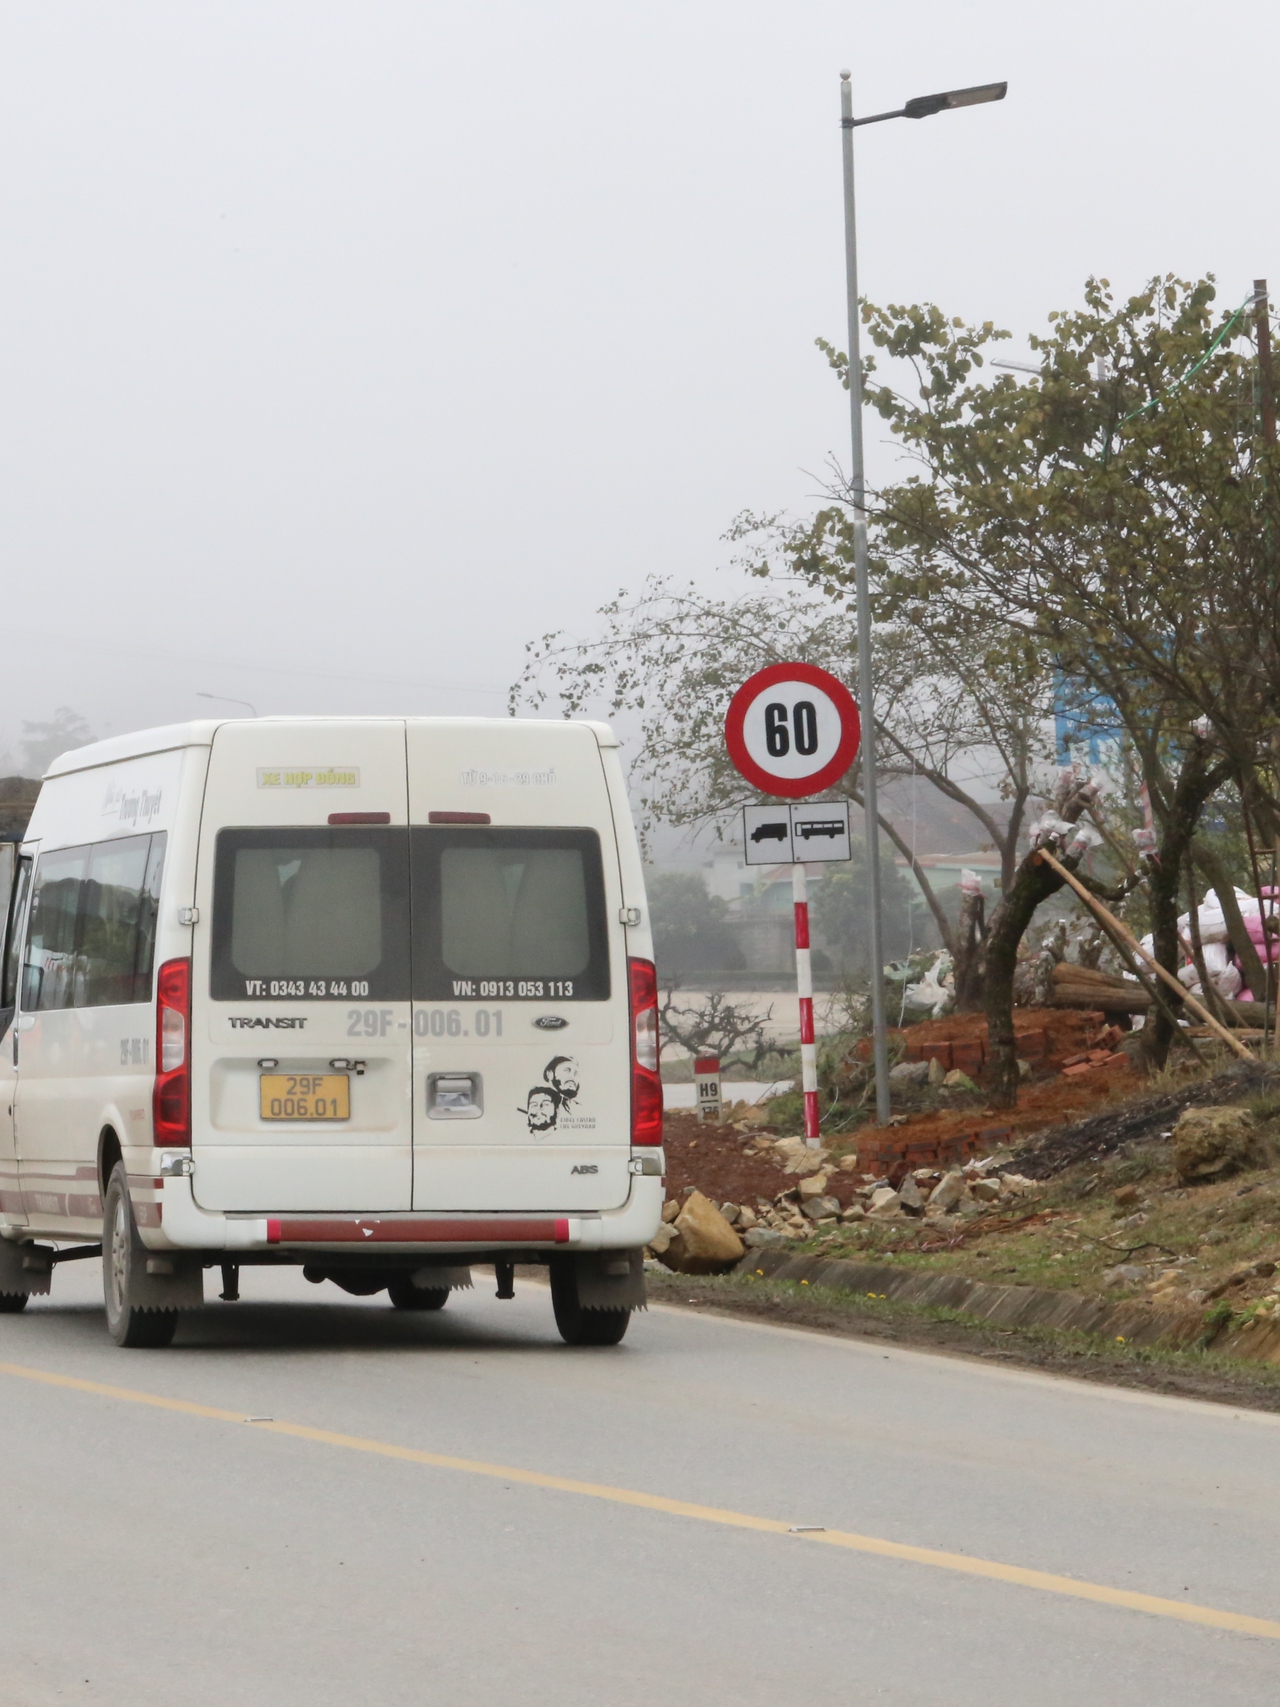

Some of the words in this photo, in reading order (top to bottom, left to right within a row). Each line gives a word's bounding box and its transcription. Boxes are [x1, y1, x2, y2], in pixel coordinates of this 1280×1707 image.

[765, 701, 818, 757] 60
[262, 772, 281, 785] XE
[245, 980, 267, 996] VT:
[270, 980, 305, 996] 0343
[308, 980, 326, 996] 43
[330, 981, 348, 996] 44
[351, 981, 369, 996] 00
[453, 980, 476, 996] VN:
[480, 981, 514, 996] 0913
[518, 981, 544, 996] 053
[548, 981, 573, 996] 113
[228, 1017, 308, 1029] TRANSIT
[286, 1077, 324, 1095] 29F
[700, 1082, 718, 1097] H9
[270, 1098, 338, 1116] 006.01
[571, 1165, 598, 1175] ABS
